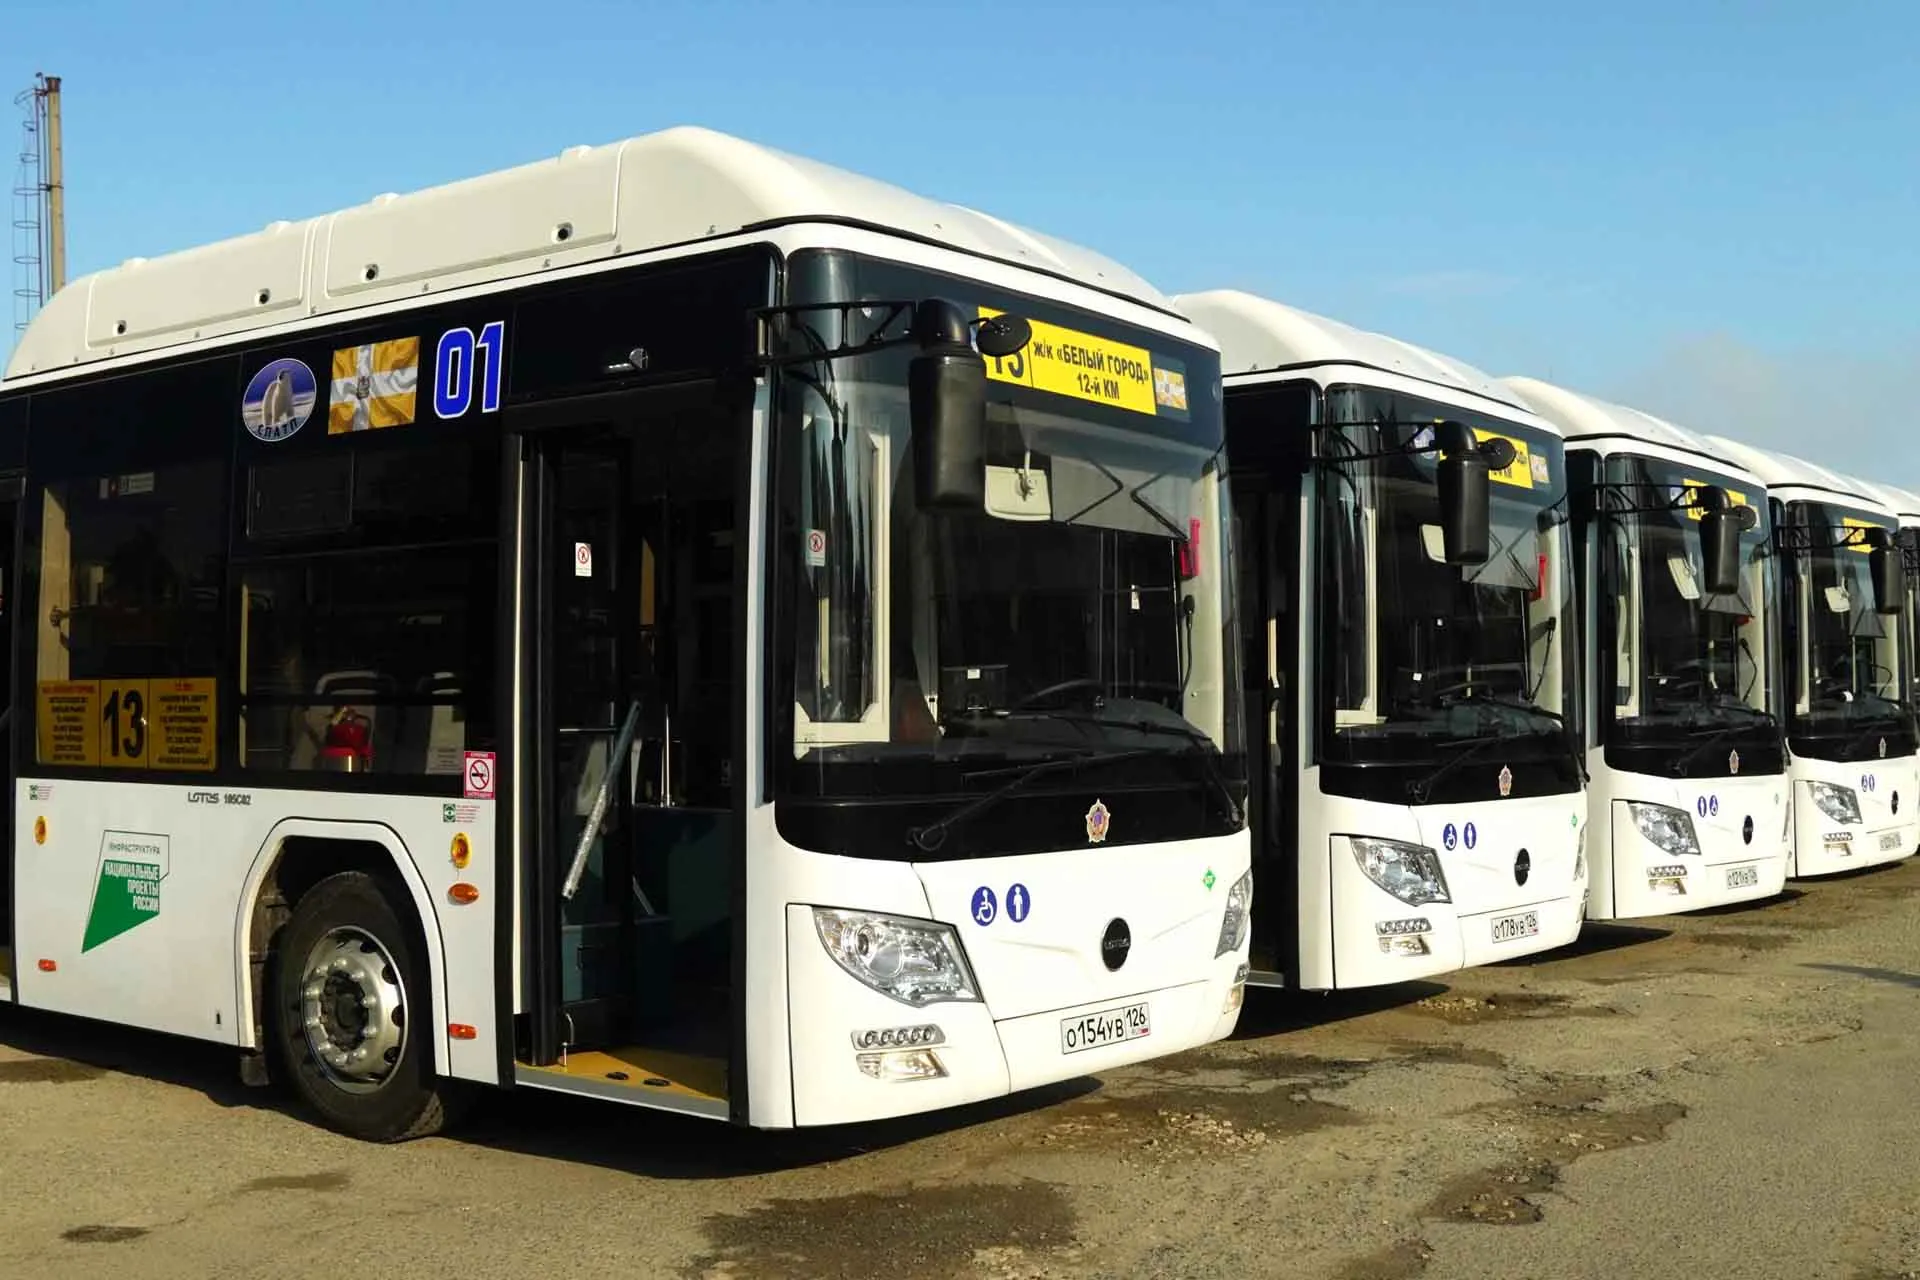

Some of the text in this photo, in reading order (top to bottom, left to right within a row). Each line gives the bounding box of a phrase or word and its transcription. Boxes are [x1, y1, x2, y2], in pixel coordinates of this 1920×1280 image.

[433, 320, 504, 419] 01
[1056, 343, 1104, 372] «БЕЛЫЙ
[1107, 357, 1149, 385] ГОРОД»
[1103, 382, 1120, 400] КМ
[103, 688, 145, 759] 13
[104, 861, 159, 881] НАЦИОНАЛЬНЫЕ
[127, 879, 159, 896] ПРОЕКТЫ
[132, 895, 159, 912] РОССИИ
[1126, 1006, 1147, 1028] 126
